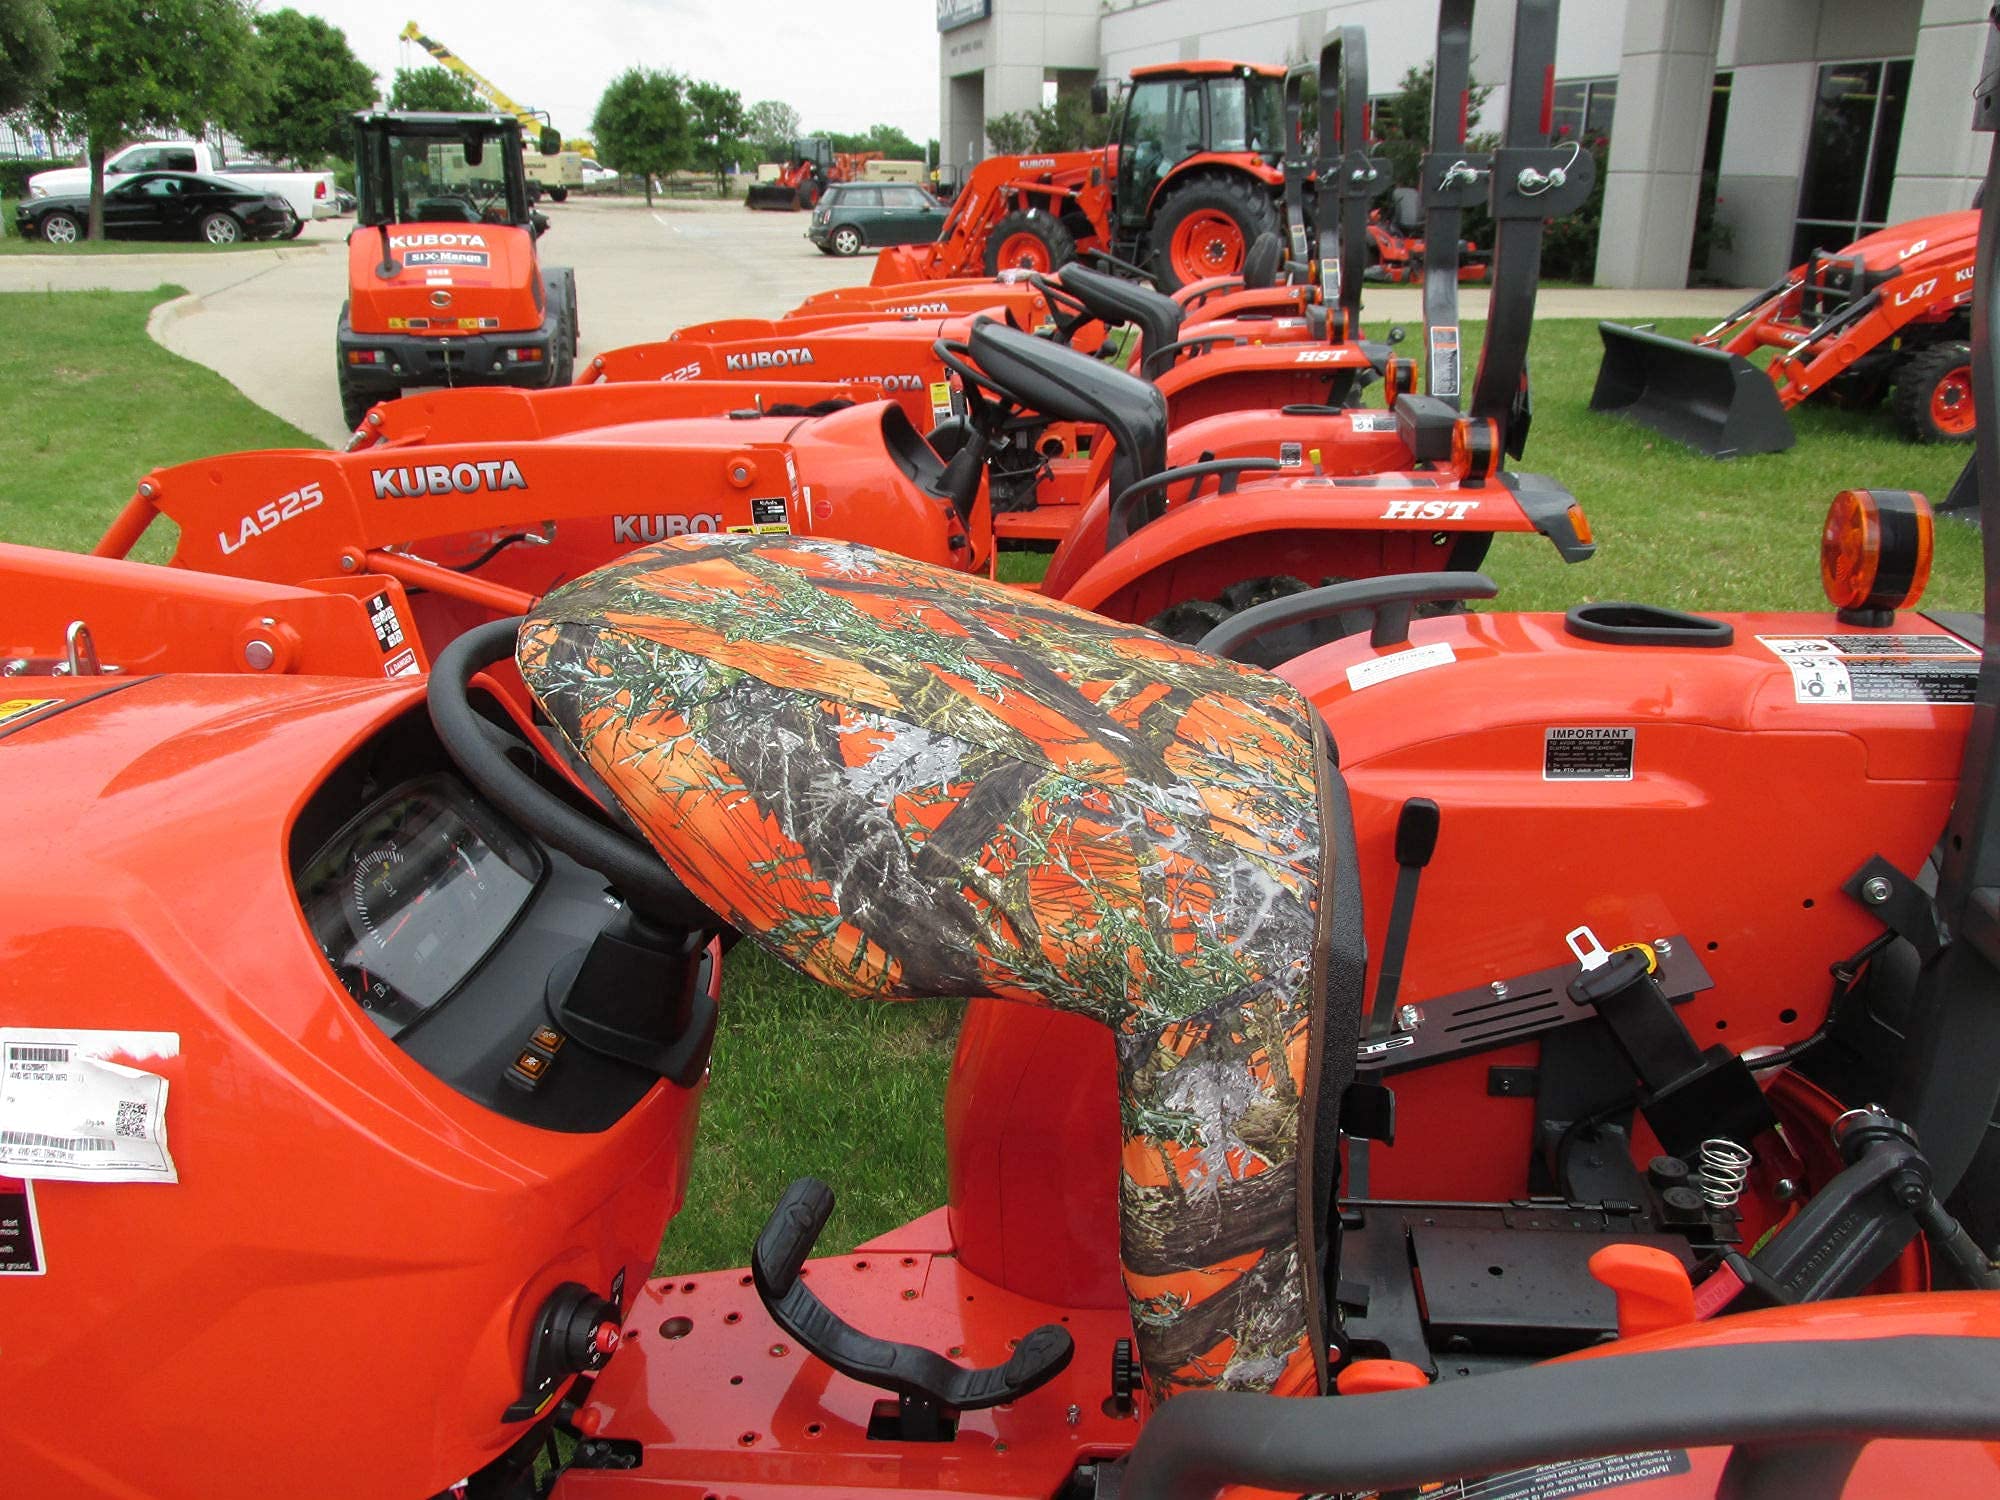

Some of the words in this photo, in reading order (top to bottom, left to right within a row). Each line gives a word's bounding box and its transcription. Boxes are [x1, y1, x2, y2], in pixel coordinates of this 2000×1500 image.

[1019, 159, 1056, 168] KUBOTA
[390, 234, 485, 248] KUBOTA
[1900, 240, 1927, 259] L47
[1895, 279, 1938, 306] L47
[726, 348, 814, 371] KUBOTA
[1295, 350, 1348, 362] HST
[371, 460, 528, 500] KUBOTA
[218, 482, 324, 556] LA525
[1380, 501, 1479, 520] HST
[613, 515, 723, 543] KUBO
[1552, 729, 1629, 739] IMPORTANT
